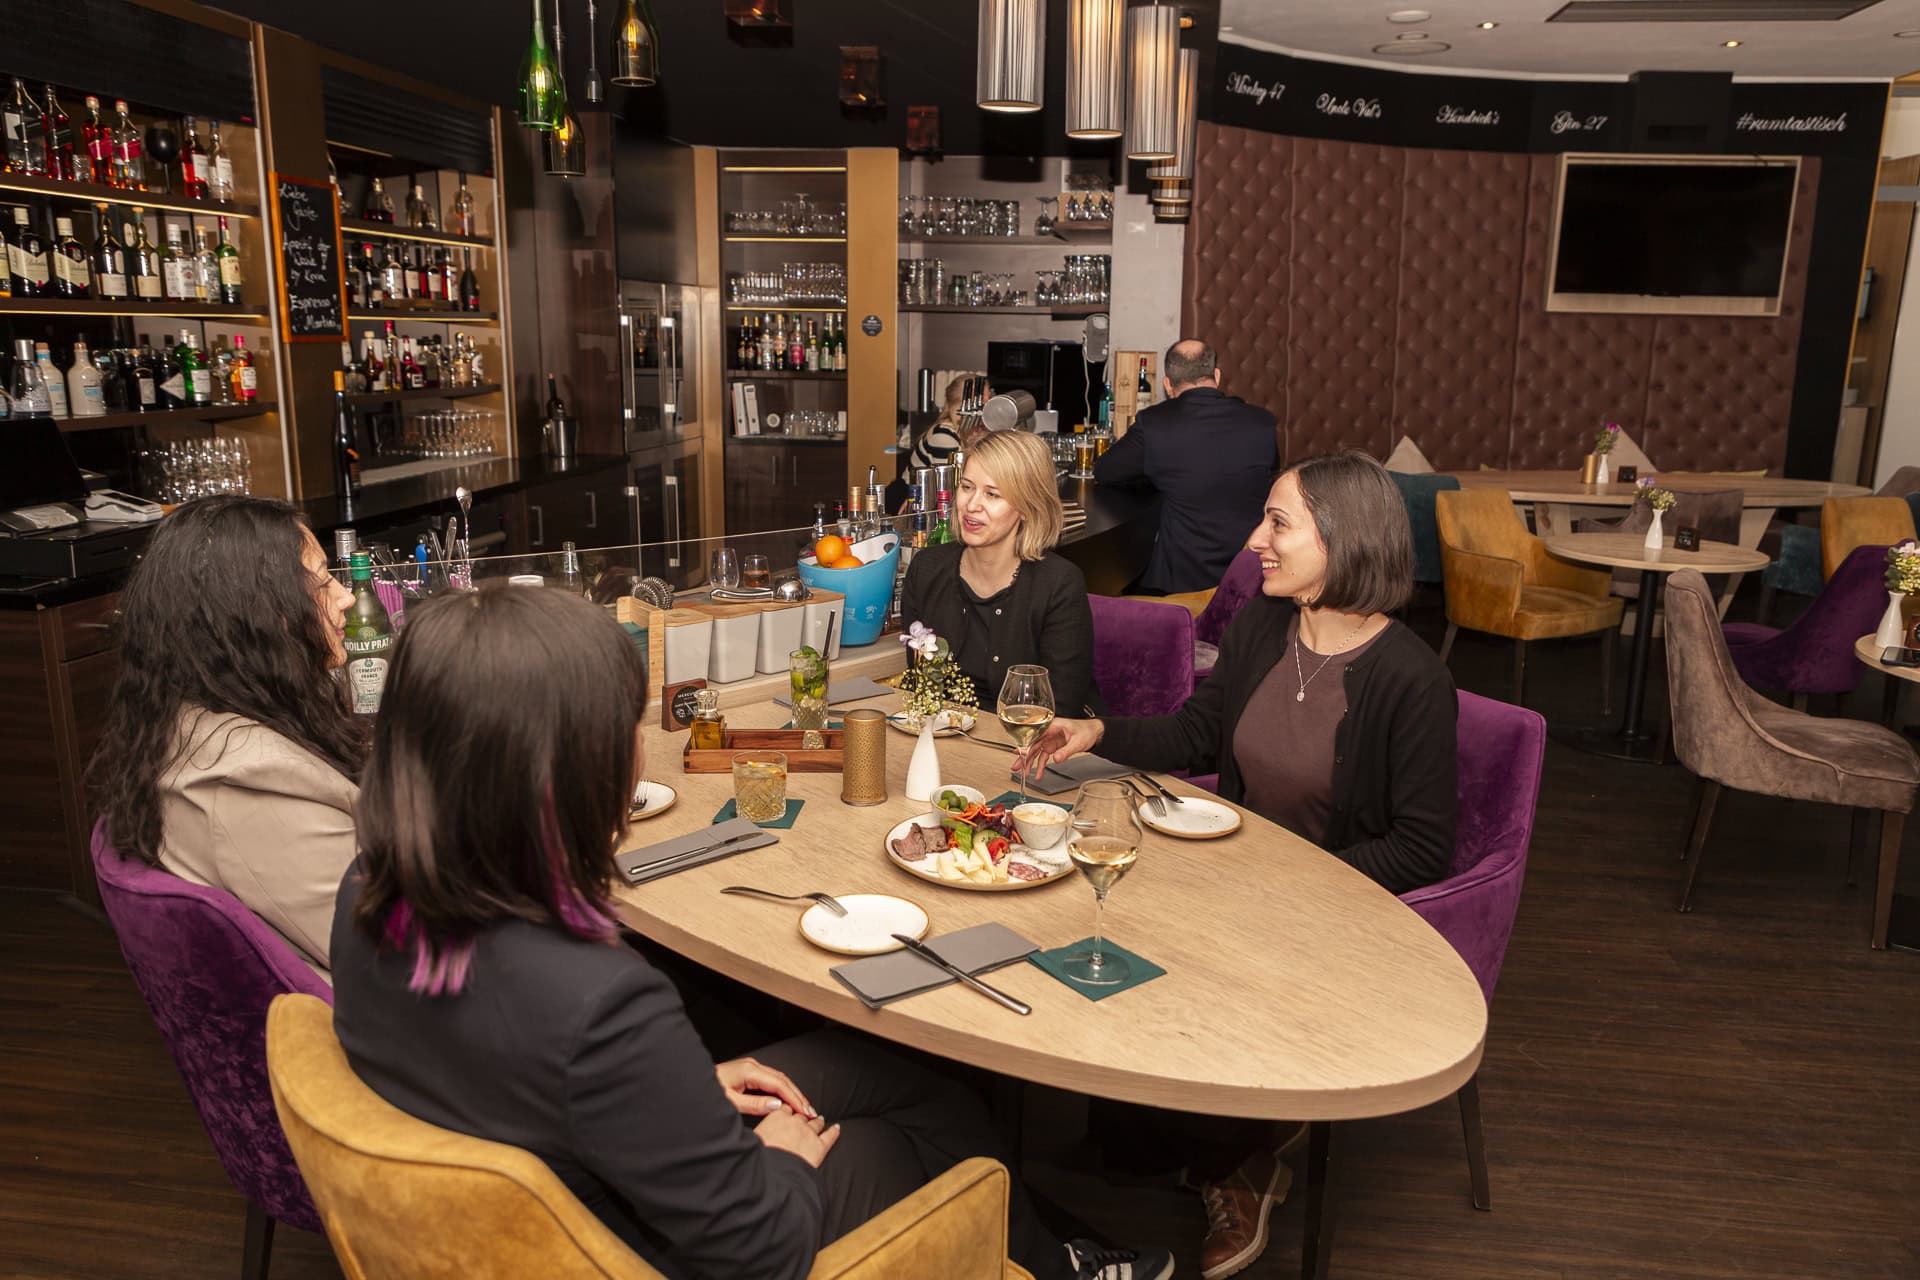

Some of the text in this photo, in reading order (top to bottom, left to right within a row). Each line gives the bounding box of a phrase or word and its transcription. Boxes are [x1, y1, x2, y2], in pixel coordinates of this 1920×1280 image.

[1226, 72, 1287, 105] Monkey 47
[1316, 93, 1382, 118] Uncle Val's
[1436, 104, 1500, 125] Hendrick's
[1551, 110, 1608, 134] Gin 27
[1736, 112, 1847, 132] #rumtastisch
[288, 293, 331, 314] Espresso
